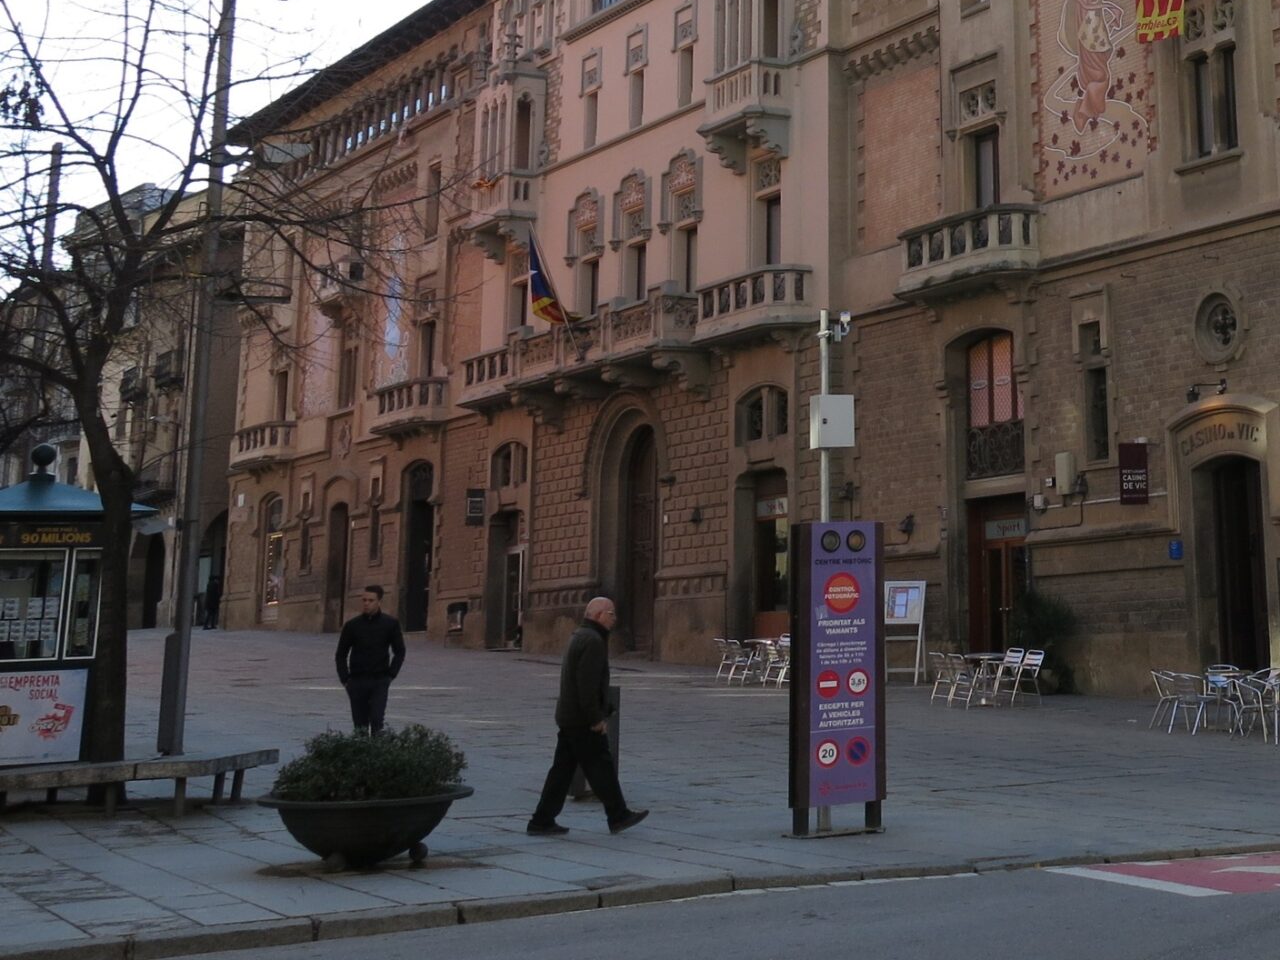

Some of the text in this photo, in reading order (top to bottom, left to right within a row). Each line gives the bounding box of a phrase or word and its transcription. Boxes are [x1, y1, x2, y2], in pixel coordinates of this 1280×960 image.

[1180, 423, 1226, 456] CASINO
[1237, 422, 1259, 442] VIC
[1135, 481, 1147, 489] VIC
[21, 532, 92, 544] 90 MILIONS
[817, 619, 852, 627] PRIORITAT
[9, 675, 60, 691] EMPREMTA
[29, 689, 58, 702] SOCIAL
[818, 700, 865, 710] EXCEPTE PER
[822, 709, 861, 719] A VEHICLES
[818, 718, 865, 728] AUTORITZATS
[821, 748, 834, 759] 20
